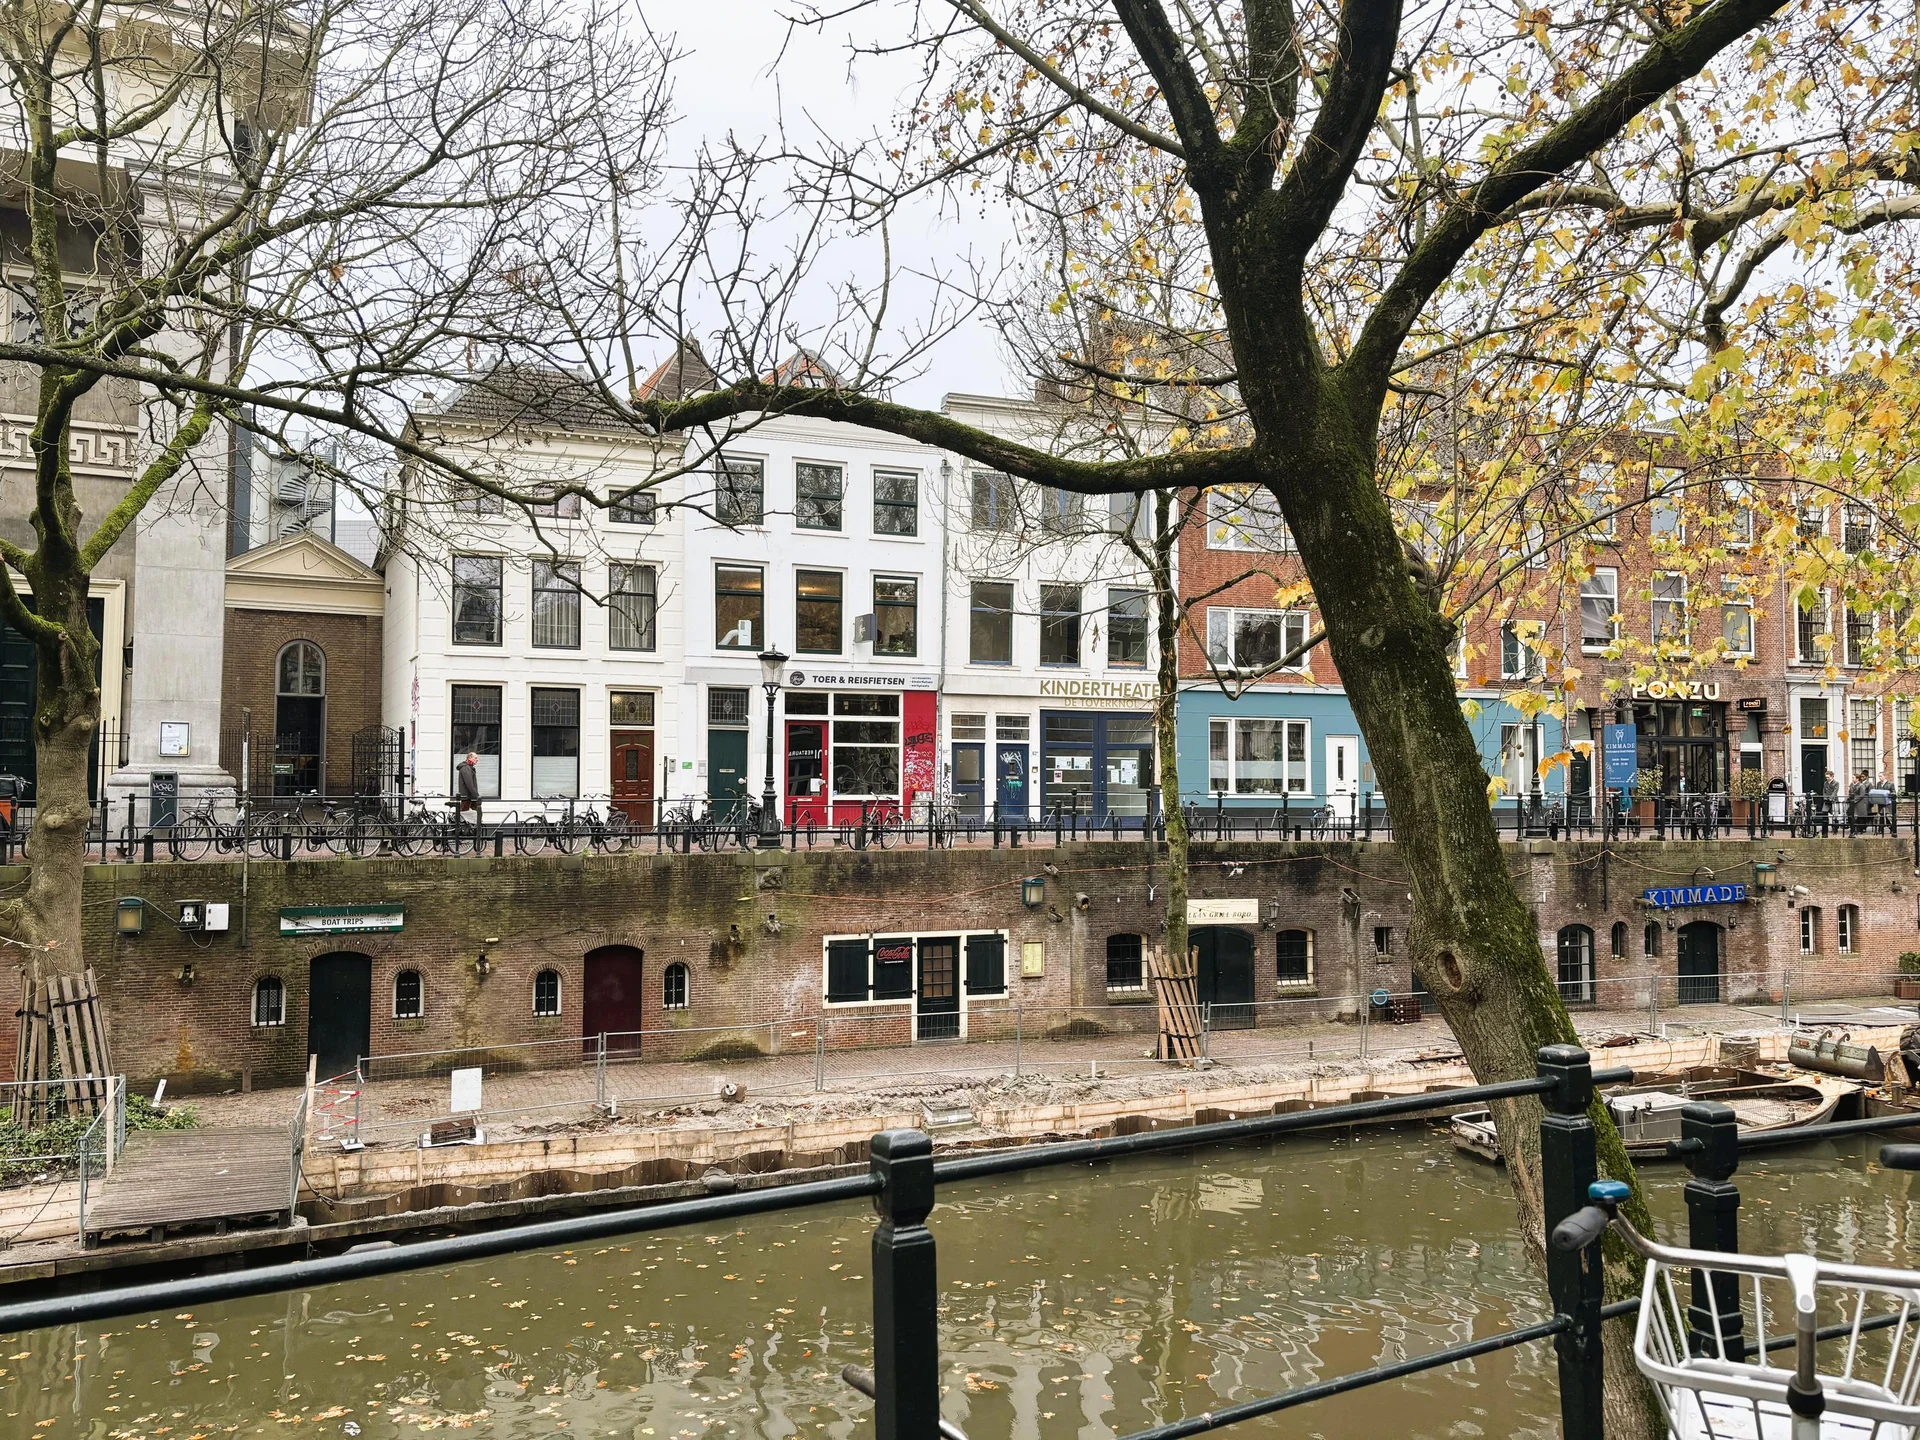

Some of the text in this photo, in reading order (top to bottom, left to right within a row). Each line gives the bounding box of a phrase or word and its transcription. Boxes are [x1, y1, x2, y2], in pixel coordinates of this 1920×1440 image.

[812, 675, 837, 684] TOER
[838, 676, 846, 684] &
[848, 676, 905, 686] REISFIETSEN
[1040, 680, 1160, 698] KINDERTHEATE
[1064, 698, 1077, 707] DE
[1647, 885, 1745, 906] KIMMADE
[321, 917, 364, 926] BOAT TRIPS
